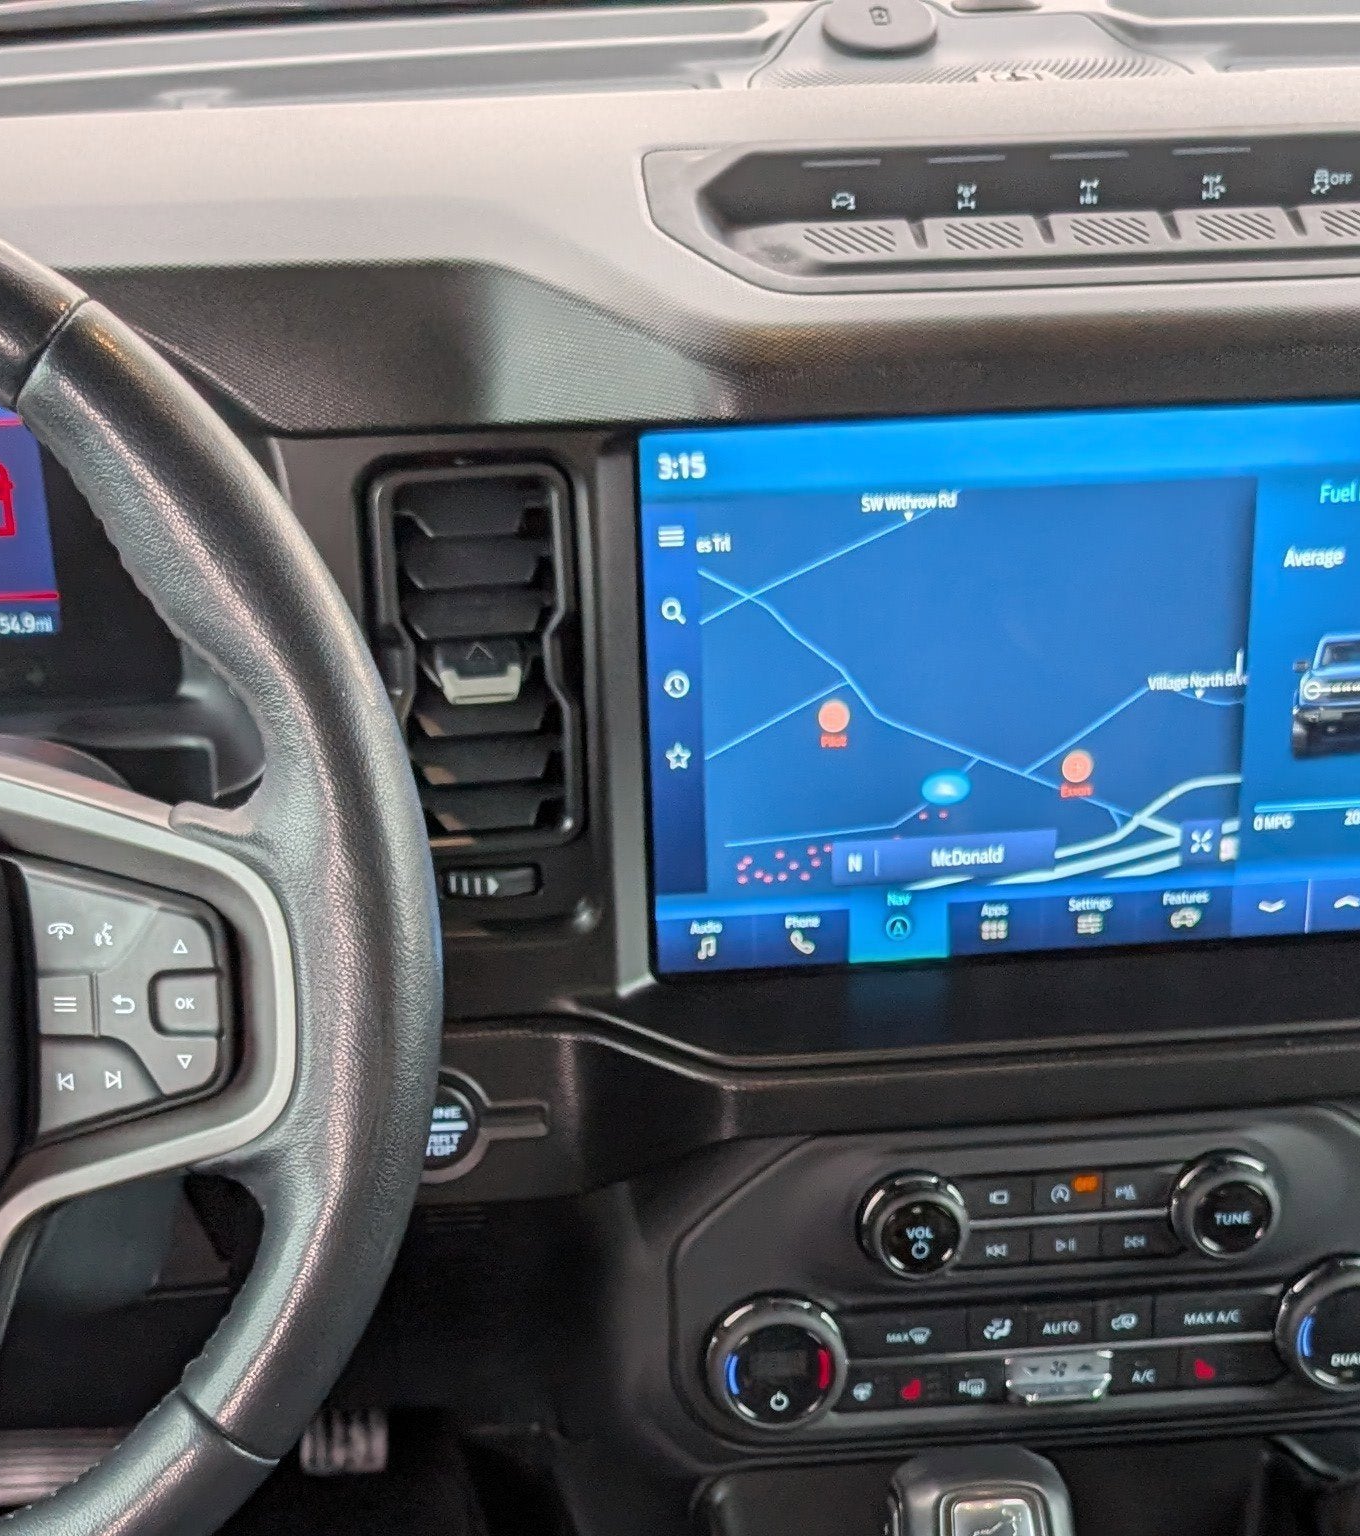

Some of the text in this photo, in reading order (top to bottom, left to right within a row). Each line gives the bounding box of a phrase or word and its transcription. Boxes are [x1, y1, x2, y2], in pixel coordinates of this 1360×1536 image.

[657, 453, 707, 480] 3:15
[1320, 481, 1355, 503] Fuel
[861, 494, 884, 513] SW
[938, 490, 958, 508] Rd
[1284, 547, 1346, 569] Average
[1148, 674, 1189, 691] Village
[1190, 672, 1224, 688] North
[1254, 814, 1294, 831] 0 MPG
[848, 853, 862, 872] N
[931, 845, 1004, 867] McDonald
[887, 891, 911, 906] Nav
[1068, 896, 1114, 912] Settings
[1163, 891, 1211, 905] Features
[981, 903, 1009, 918] Apps
[690, 921, 722, 936] Audio
[785, 915, 821, 929] Phone
[175, 997, 195, 1010] OK
[1214, 1212, 1251, 1226] TUNE
[906, 1227, 933, 1240] VOL
[1184, 1309, 1241, 1326] MAX A/C
[1042, 1320, 1081, 1335] AUTO
[886, 1331, 909, 1344] MAX
[1131, 1368, 1157, 1385] A/C
